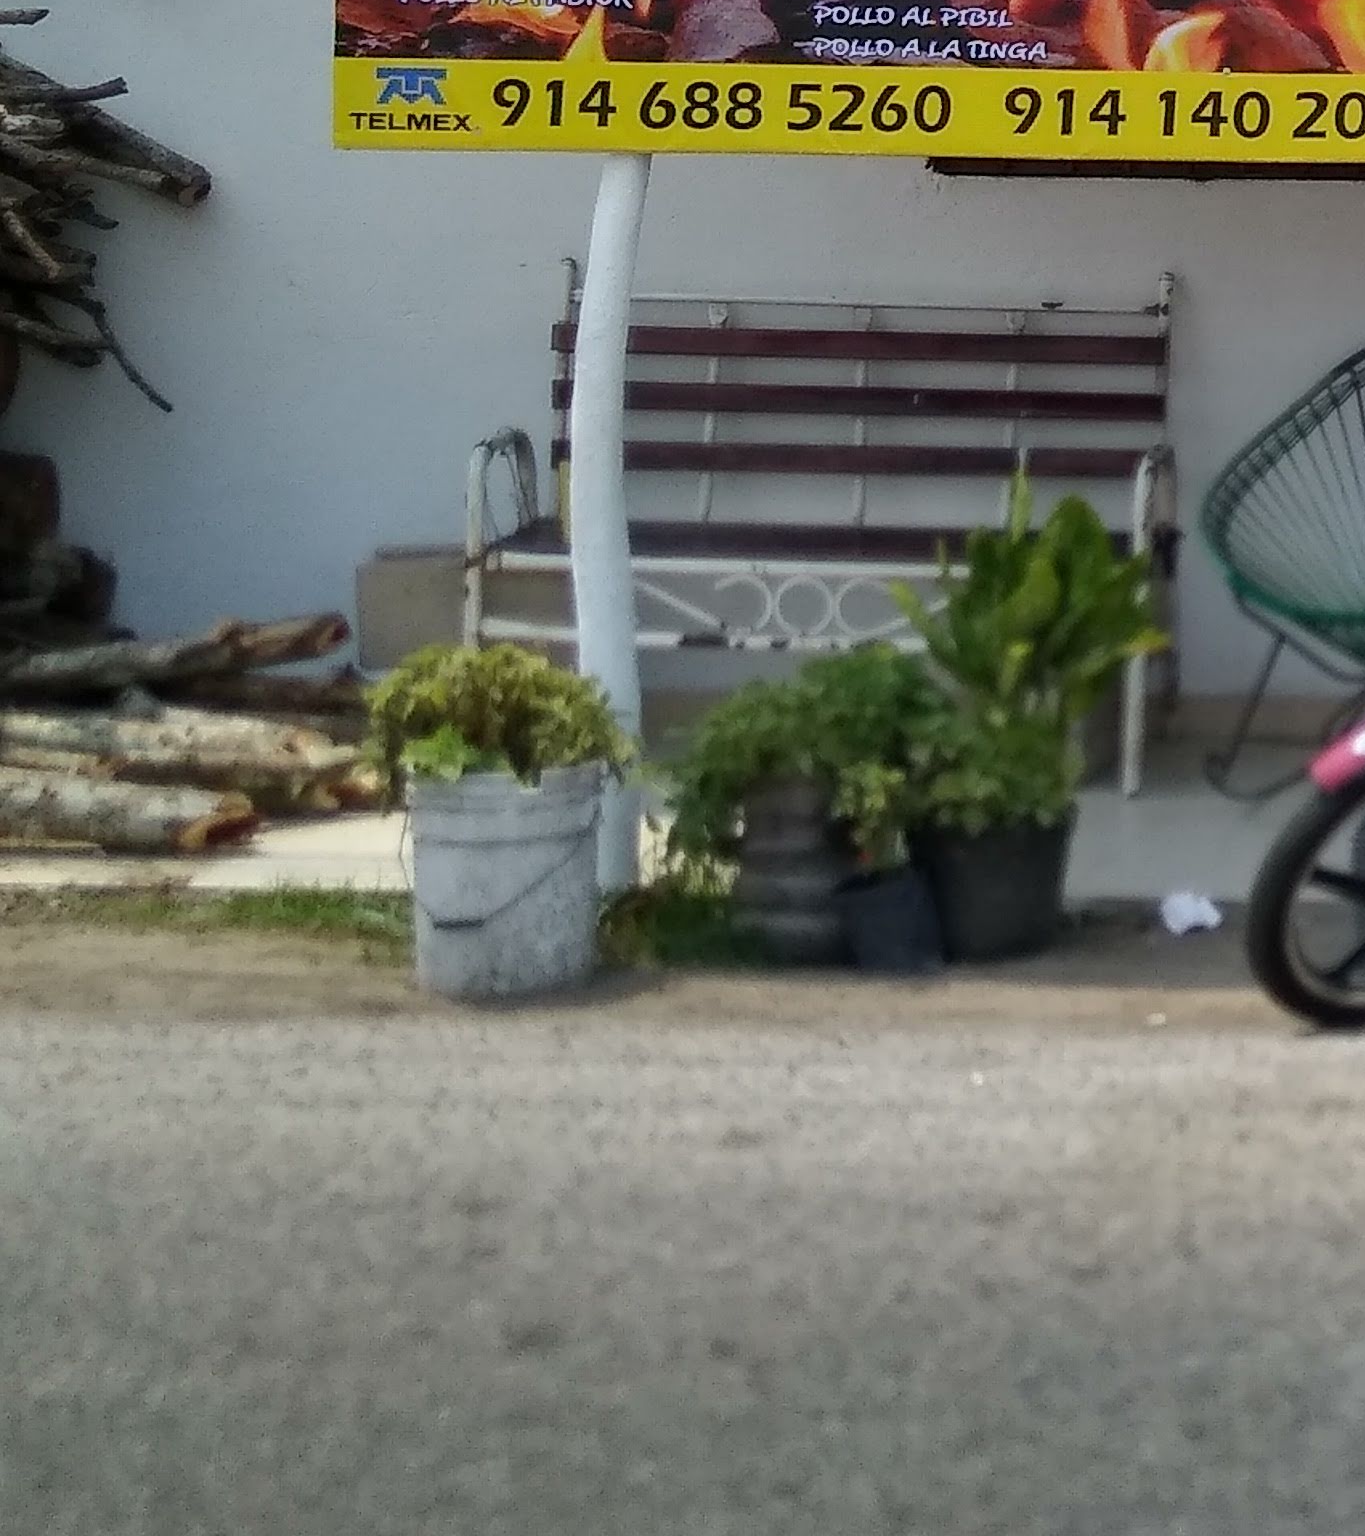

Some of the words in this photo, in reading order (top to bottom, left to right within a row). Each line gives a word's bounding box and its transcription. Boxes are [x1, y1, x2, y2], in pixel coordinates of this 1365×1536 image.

[814, 5, 895, 25] POLLO
[901, 6, 937, 26] AL
[941, 7, 1013, 28] PIBIL
[812, 37, 894, 57] POLLO
[901, 39, 921, 58] A
[927, 41, 961, 59] LA
[965, 40, 1047, 61] TINGA
[492, 78, 617, 129] 914
[639, 80, 763, 131] 688
[785, 82, 953, 134] 5260
[1004, 86, 1127, 137] 914
[1158, 89, 1271, 139] 140
[350, 112, 473, 132] TELMEX
